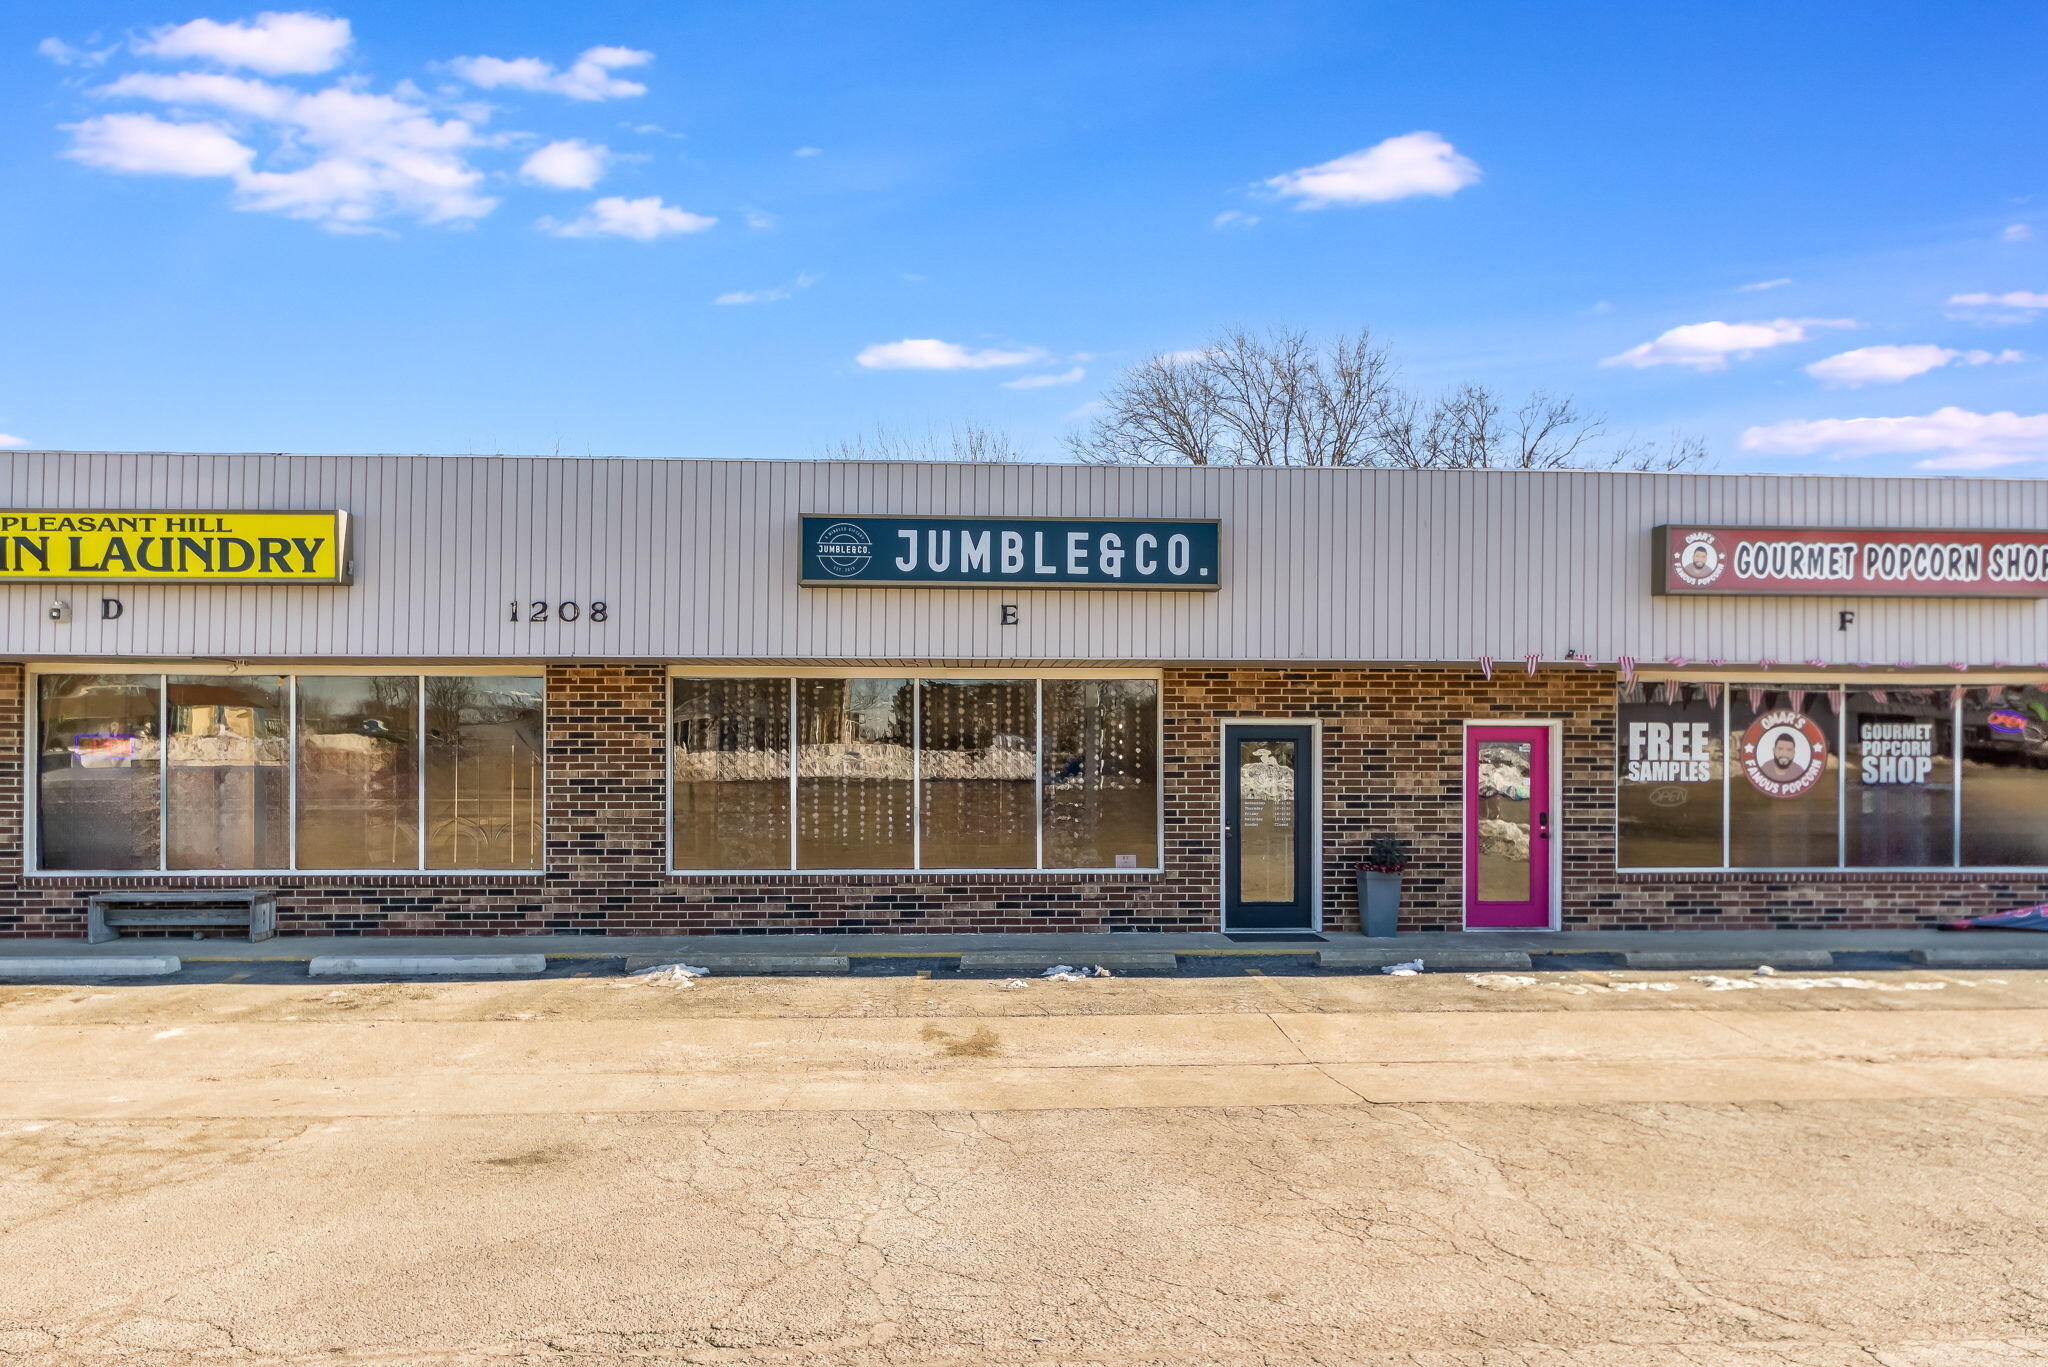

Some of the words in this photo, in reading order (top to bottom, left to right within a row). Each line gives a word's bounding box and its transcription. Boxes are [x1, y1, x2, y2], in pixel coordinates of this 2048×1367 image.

[2, 517, 156, 533] PLEASANT
[166, 518, 232, 533] HILL
[69, 536, 325, 573] LAUNDRY
[818, 545, 871, 554] JUMBLE&CO.
[894, 529, 1209, 577] JUMBLE&CO.
[1734, 541, 1859, 580] GOURMET
[1863, 542, 1983, 581] POPCORN
[102, 599, 123, 619] D
[509, 600, 608, 622] 1208
[1000, 604, 1019, 626] E
[1839, 611, 1854, 631] F
[1760, 711, 1806, 730] OMAR'S
[1628, 722, 1710, 761] FREE
[1861, 724, 1933, 740] GOURMET
[1862, 740, 1931, 757] POPCORN
[1628, 761, 1711, 782] SAMPLES
[1745, 759, 1780, 794] FAMOUS
[1781, 759, 1822, 795] POPCORN
[1861, 756, 1933, 784] SHOP
